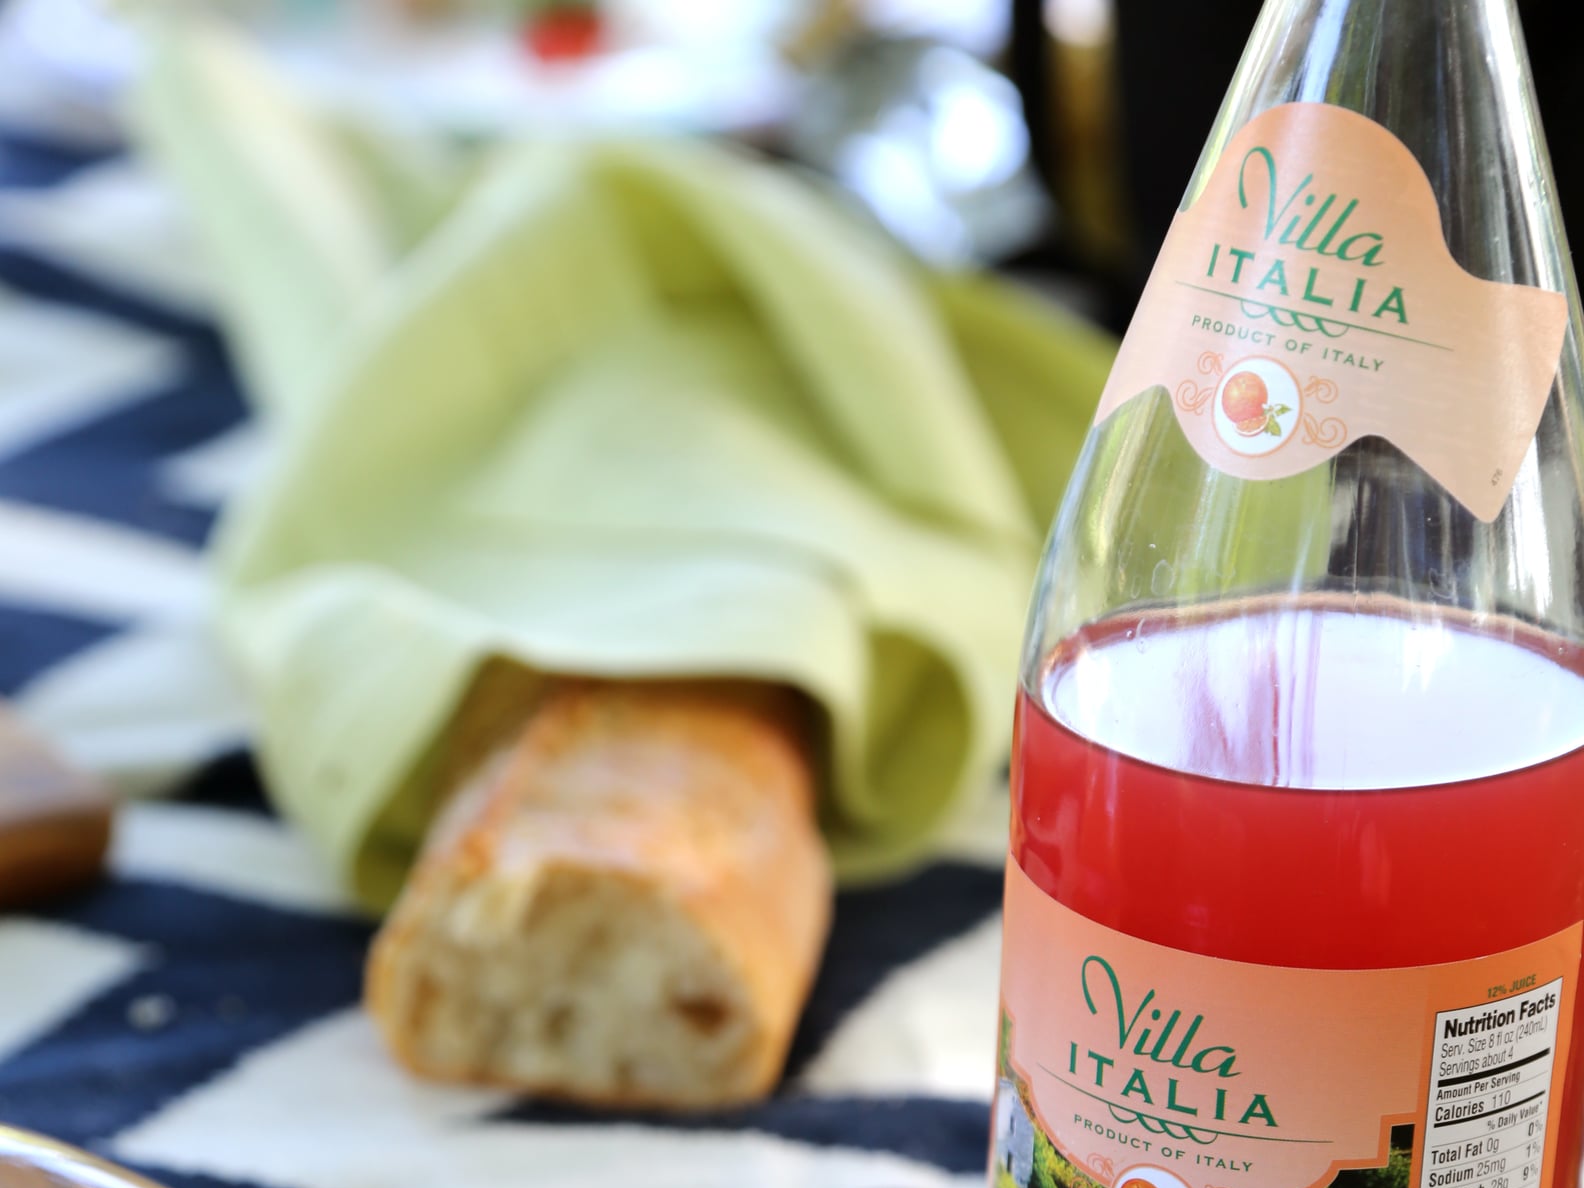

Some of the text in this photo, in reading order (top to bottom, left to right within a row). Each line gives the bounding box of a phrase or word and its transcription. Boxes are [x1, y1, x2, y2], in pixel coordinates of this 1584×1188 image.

[1238, 146, 1385, 267] Villa
[1206, 244, 1409, 324] ITALIA
[1192, 315, 1385, 372] PRODUCT OF ITALY
[1487, 974, 1537, 998] 12% JUICE
[1081, 955, 1242, 1078] Villa
[1441, 1043, 1465, 1058] Serv.
[1468, 1037, 1487, 1054] Size
[1488, 1033, 1495, 1049] 8
[1504, 1030, 1514, 1043] oz
[1515, 1015, 1548, 1043] (240mL)
[1444, 992, 1556, 1039] Nutrition Facts
[1068, 1040, 1278, 1128] ITALIA
[1439, 1046, 1514, 1077] Servings about 4
[1435, 1089, 1511, 1122] Calories 110
[1436, 1072, 1521, 1101] Amount Per Serving
[1073, 1114, 1254, 1173] PRODUCT OF ITALY
[1431, 1119, 1543, 1165] Total Fat 0g 0%
[1487, 1120, 1496, 1131] %
[1497, 1112, 1518, 1129] Daily
[1428, 1141, 1541, 1188] Sodium 25mg 1%
